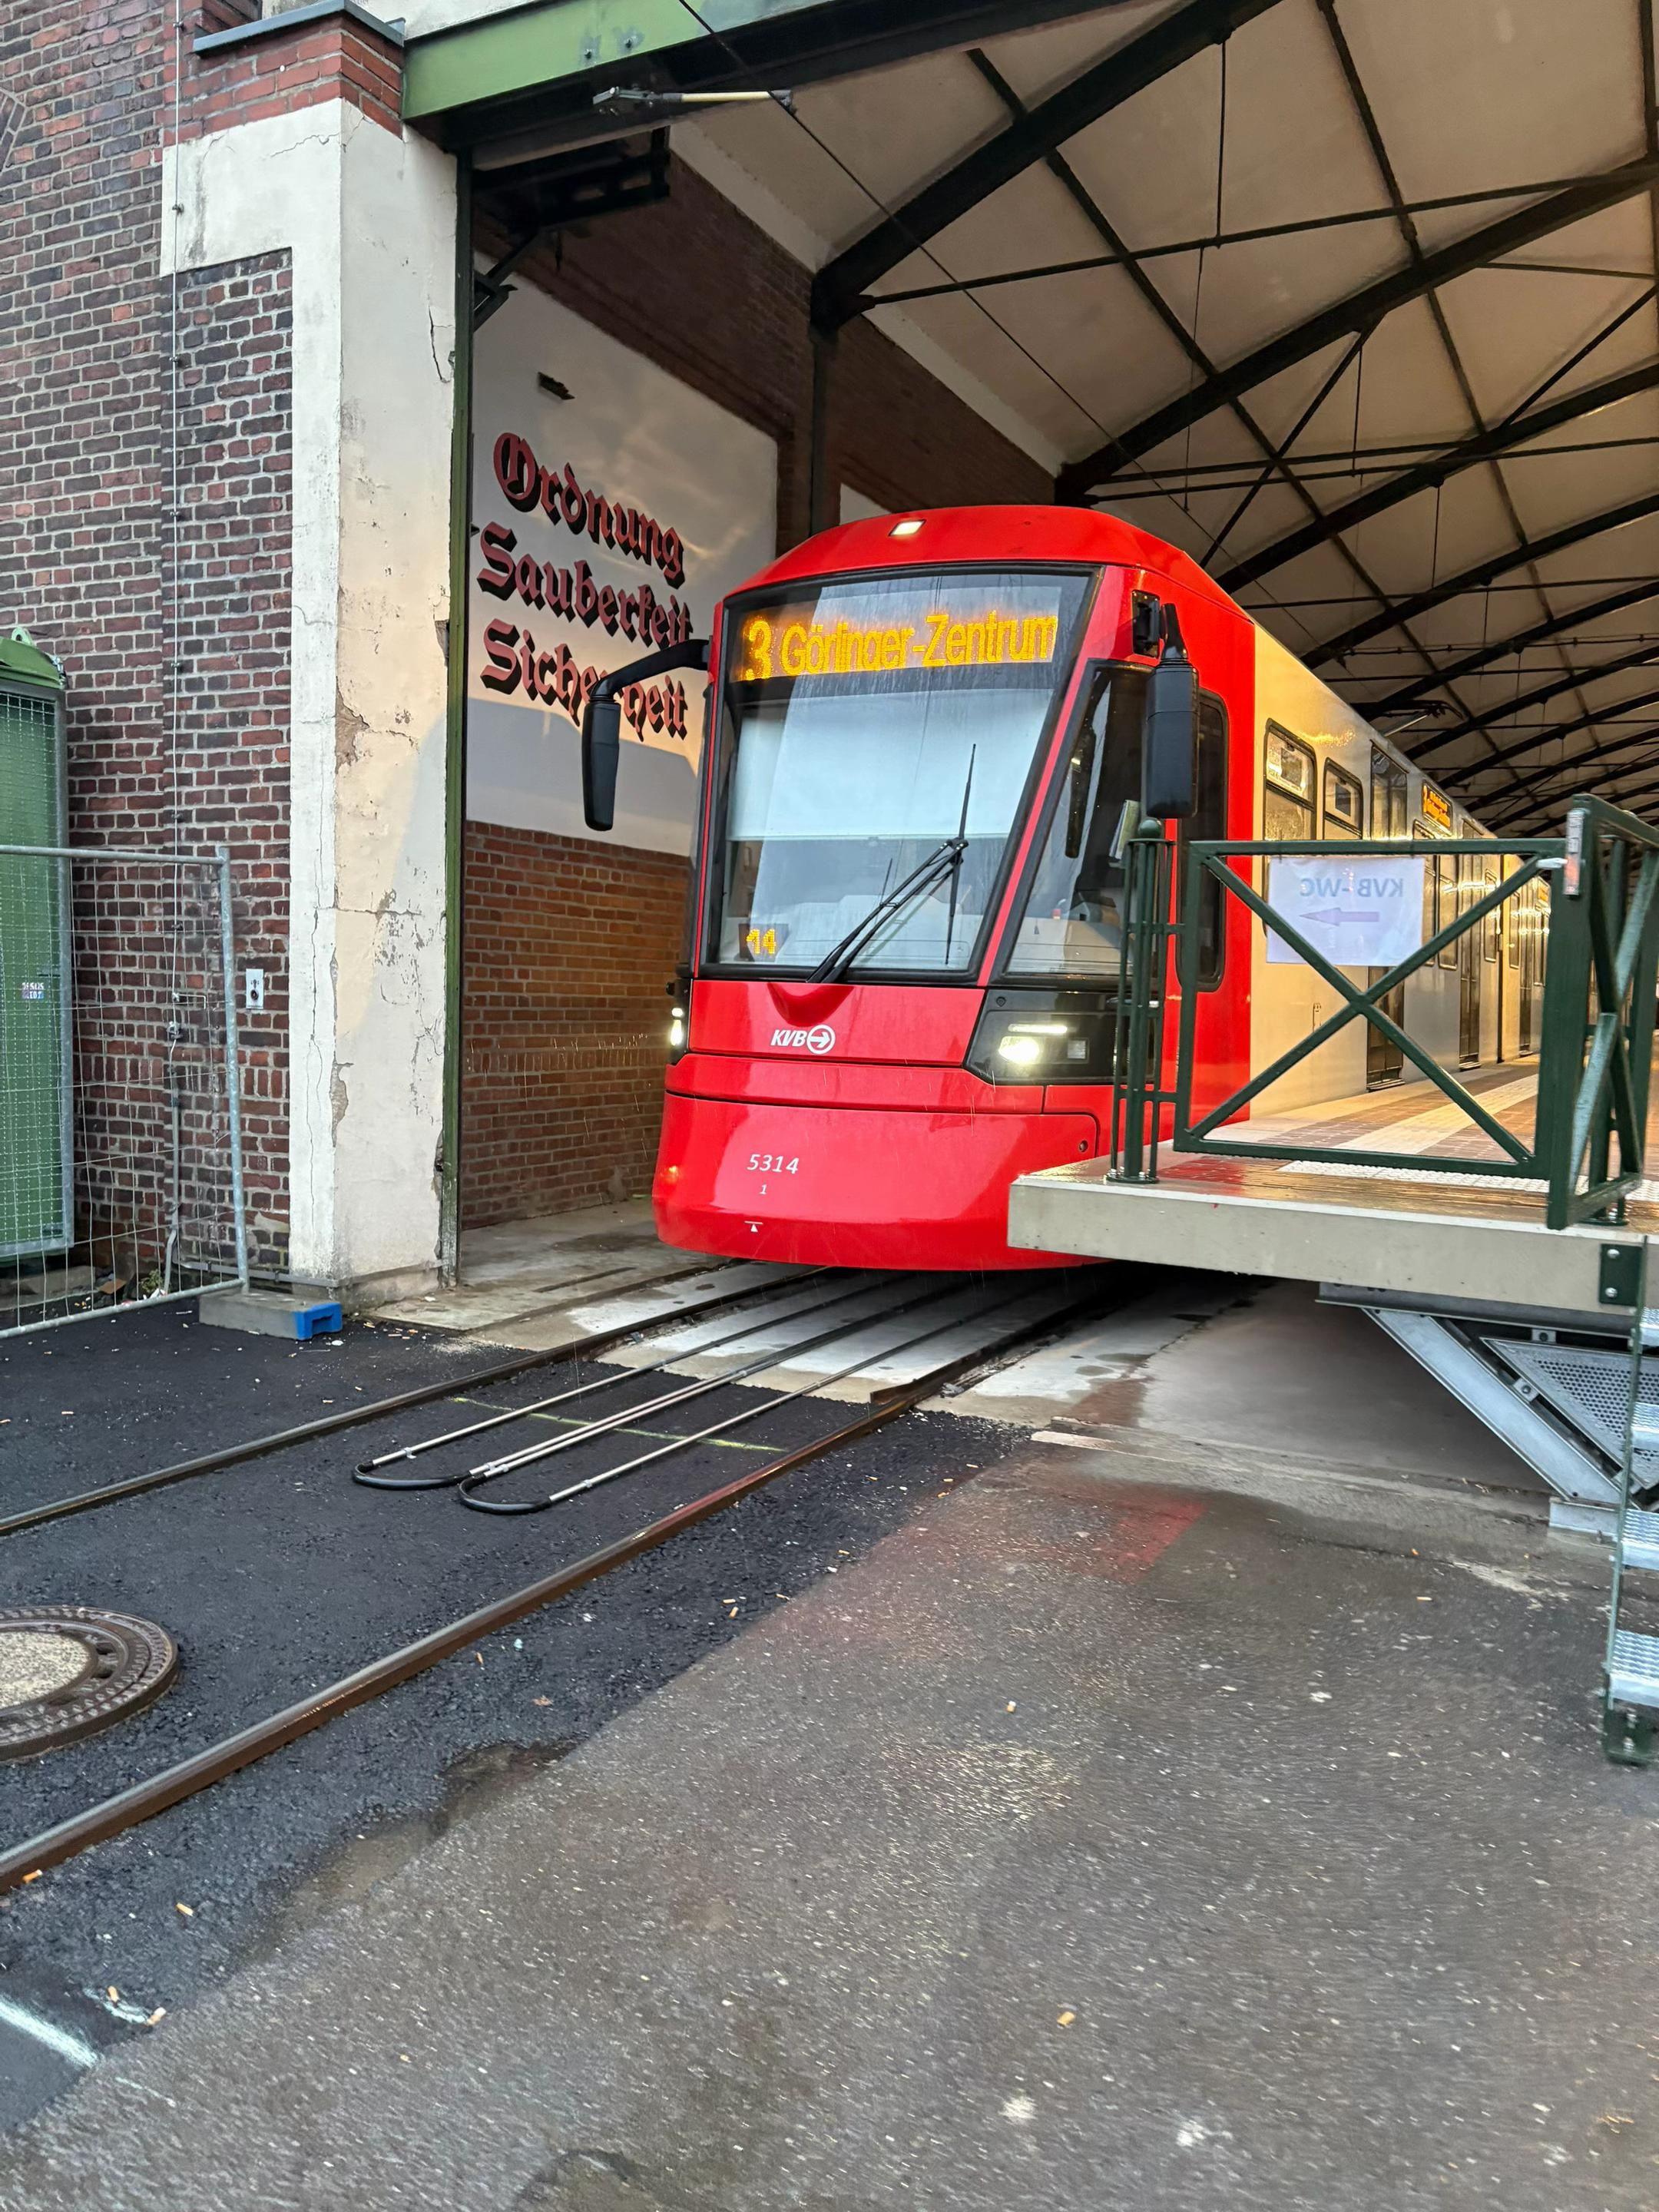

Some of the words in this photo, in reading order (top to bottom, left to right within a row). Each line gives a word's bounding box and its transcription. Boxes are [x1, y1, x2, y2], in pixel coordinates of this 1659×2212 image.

[493, 432, 686, 590] Ordnung
[476, 521, 694, 651] Sauberkeit
[744, 618, 772, 680] 3
[779, 611, 1058, 677] Görlinger-Zentrum
[480, 618, 689, 742] Sicheheit
[746, 929, 777, 955] 14
[770, 1029, 808, 1047] KVB
[747, 1154, 800, 1174] 5314
[759, 1184, 767, 1195] 1
